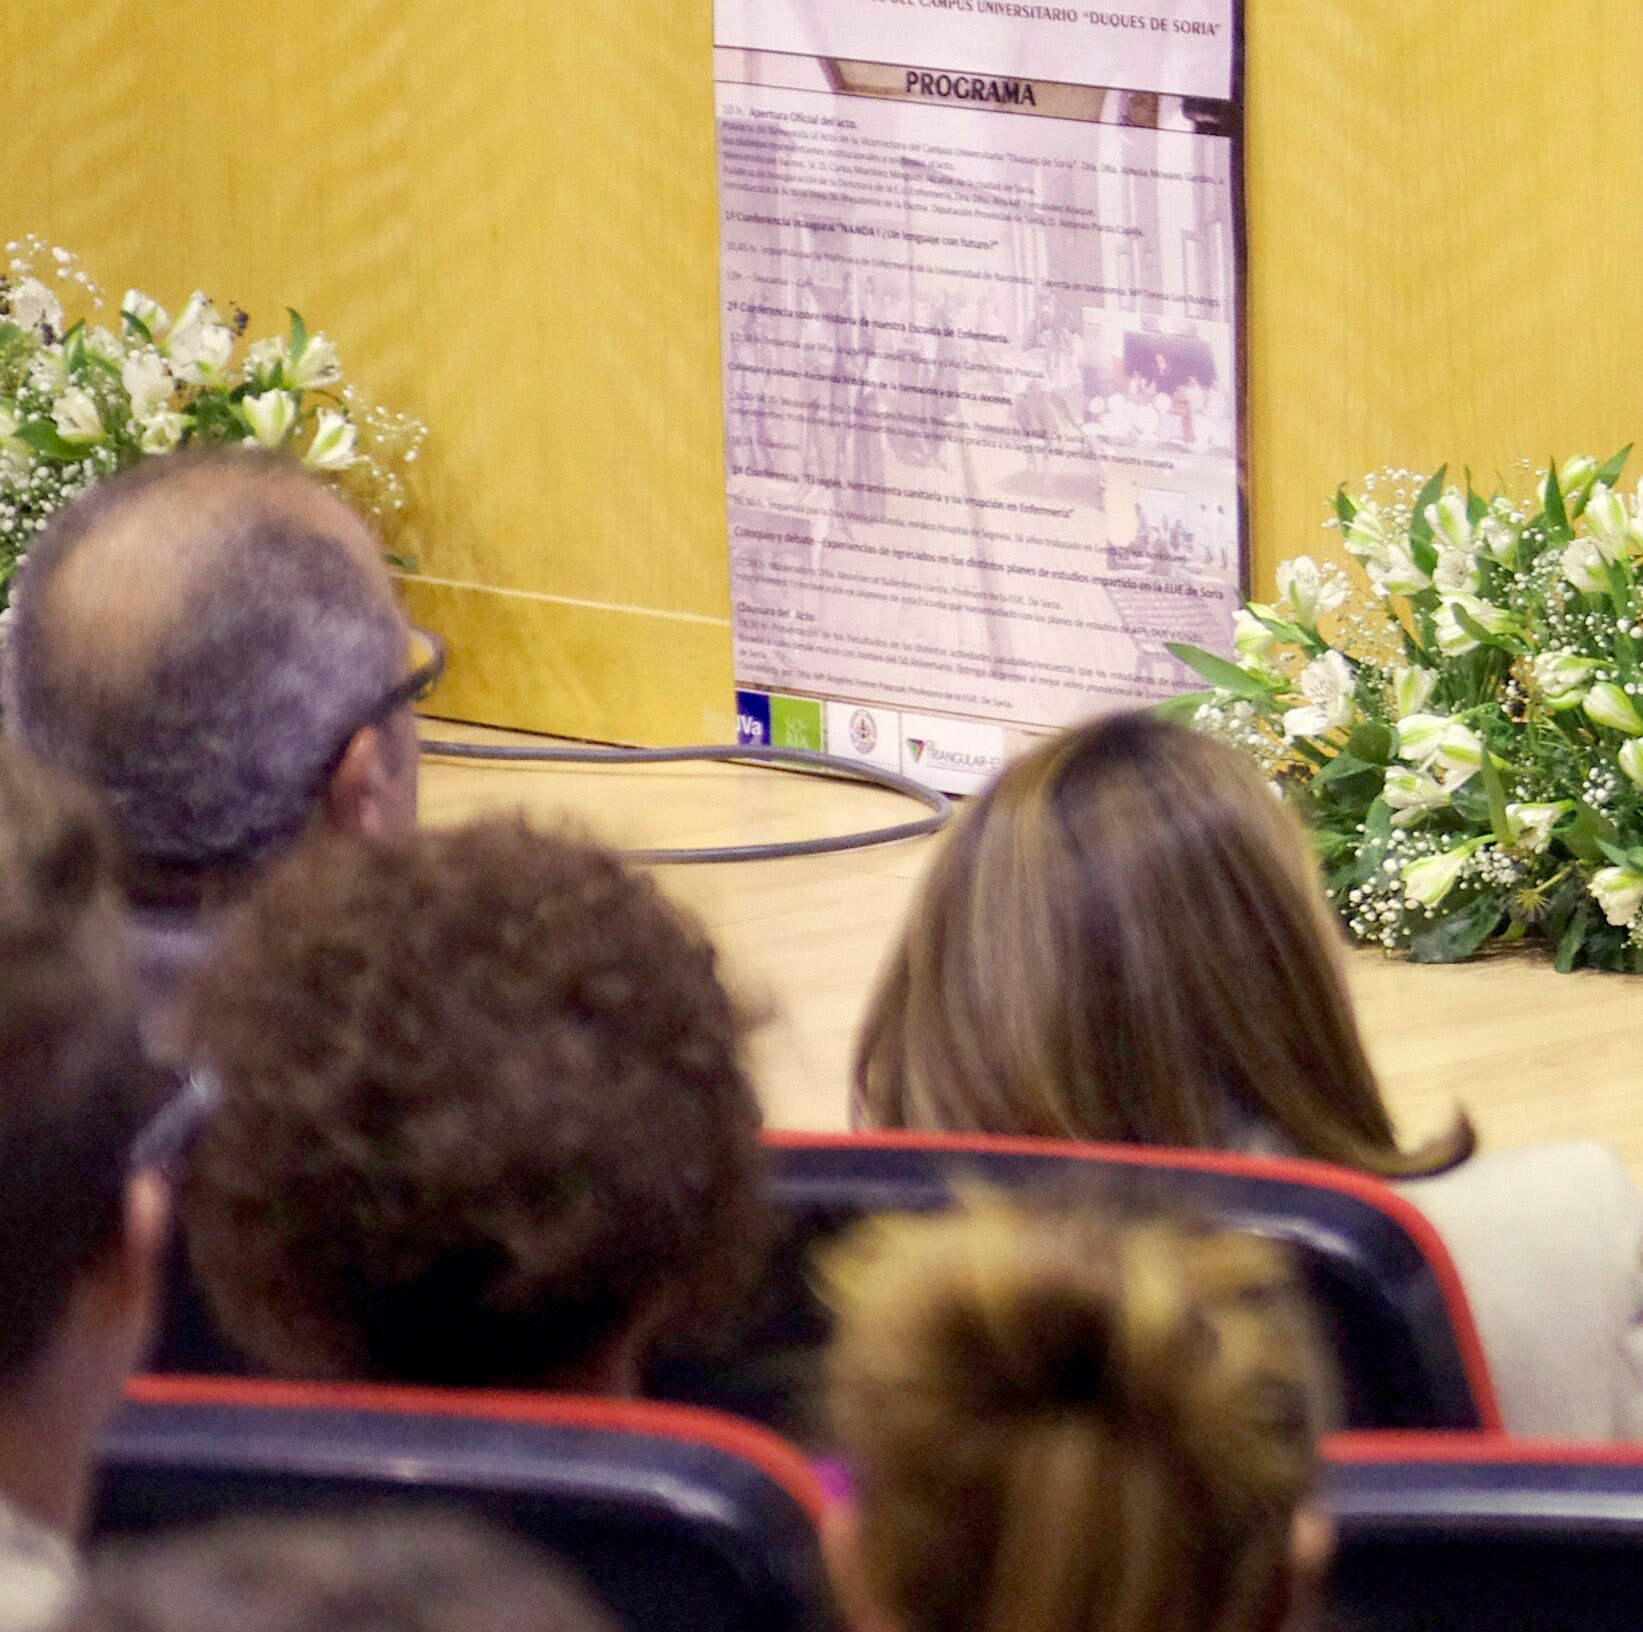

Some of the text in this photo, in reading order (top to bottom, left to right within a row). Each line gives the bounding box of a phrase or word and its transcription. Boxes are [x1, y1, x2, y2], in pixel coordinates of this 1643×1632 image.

[1150, 16, 1168, 33] DE
[905, 71, 1038, 107] PROGRAMA
[750, 108, 787, 123] Apertura
[737, 211, 790, 226] Conferencia
[902, 230, 939, 246] lenguaje
[943, 238, 958, 246] con
[740, 302, 792, 317] Conferencia
[908, 323, 941, 335] Escuela
[943, 327, 954, 337] de
[904, 487, 941, 500] sanitaria
[951, 495, 961, 503] su
[1006, 502, 1017, 510] en
[734, 528, 774, 543] Coloquio
[785, 534, 813, 546] debate
[822, 539, 876, 556] Experiencias
[879, 547, 889, 556] de
[892, 548, 935, 564] egresados
[950, 556, 963, 565] los
[1006, 563, 1036, 577] planes
[1038, 567, 1048, 577] de
[1051, 569, 1088, 582] estudios
[1091, 574, 1136, 590] impartido
[1139, 582, 1150, 590] en
[1153, 582, 1162, 591] la
[1164, 584, 1183, 594] EUE
[1186, 587, 1197, 596] de
[1200, 589, 1223, 599] Soria
